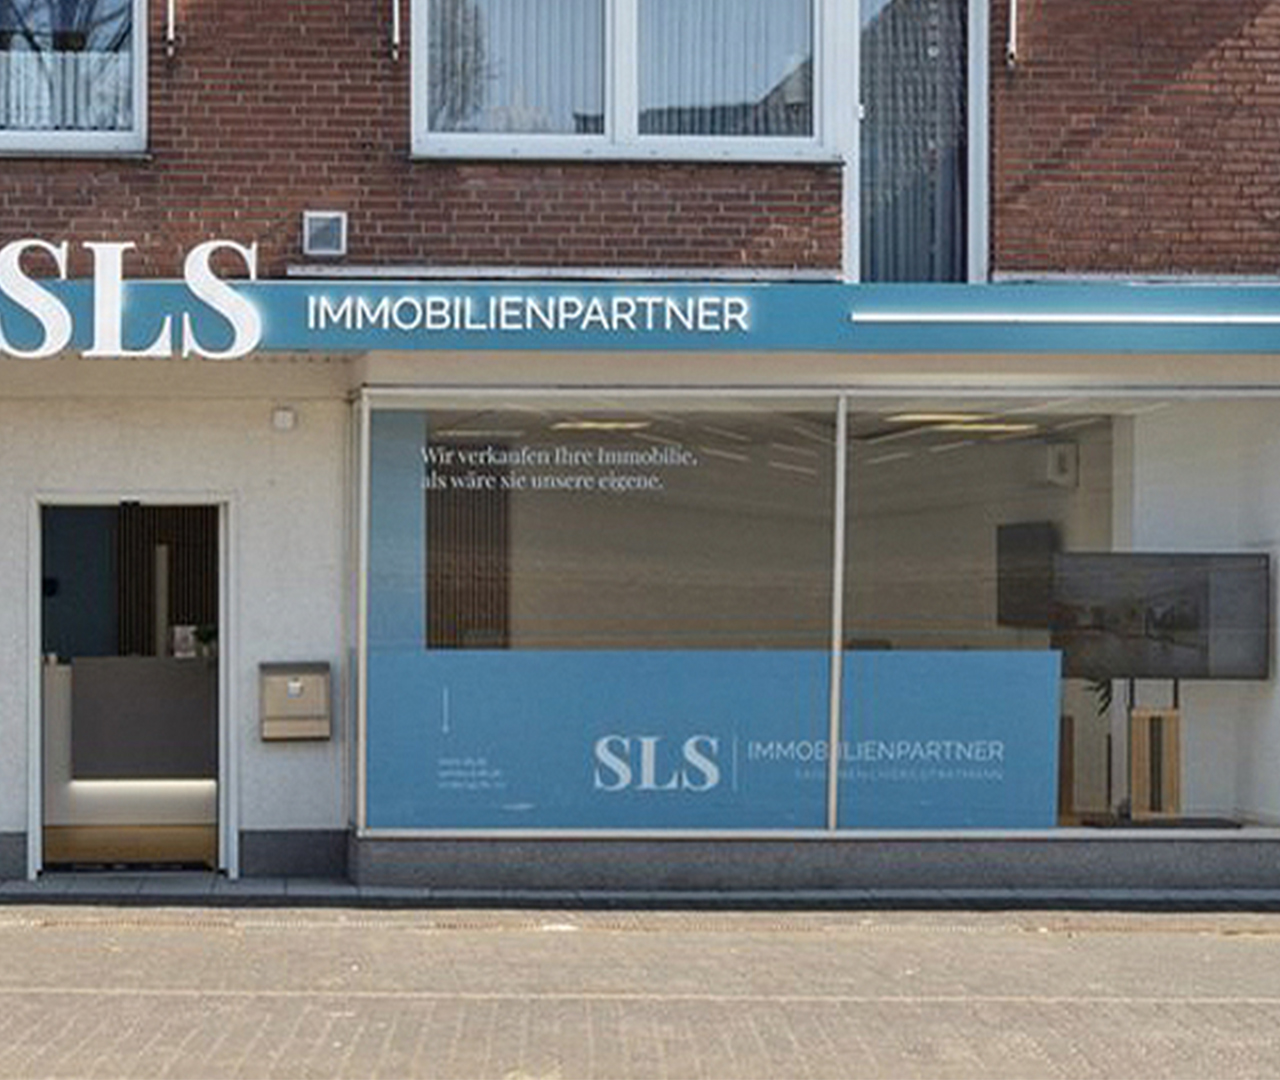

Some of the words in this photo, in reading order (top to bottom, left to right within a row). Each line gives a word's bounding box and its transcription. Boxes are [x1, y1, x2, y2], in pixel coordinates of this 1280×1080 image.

[307, 295, 751, 332] IMMOBILIENPARTNER
[421, 446, 455, 465] Wir
[457, 446, 551, 465] verkaufen
[554, 447, 594, 467] Ihre
[597, 447, 698, 467] Immobilie,
[421, 471, 447, 489] als
[449, 472, 496, 489] wäre
[500, 472, 525, 489] sie
[530, 474, 595, 489] unsere
[598, 472, 663, 492] eigene.
[594, 735, 720, 792] SLS
